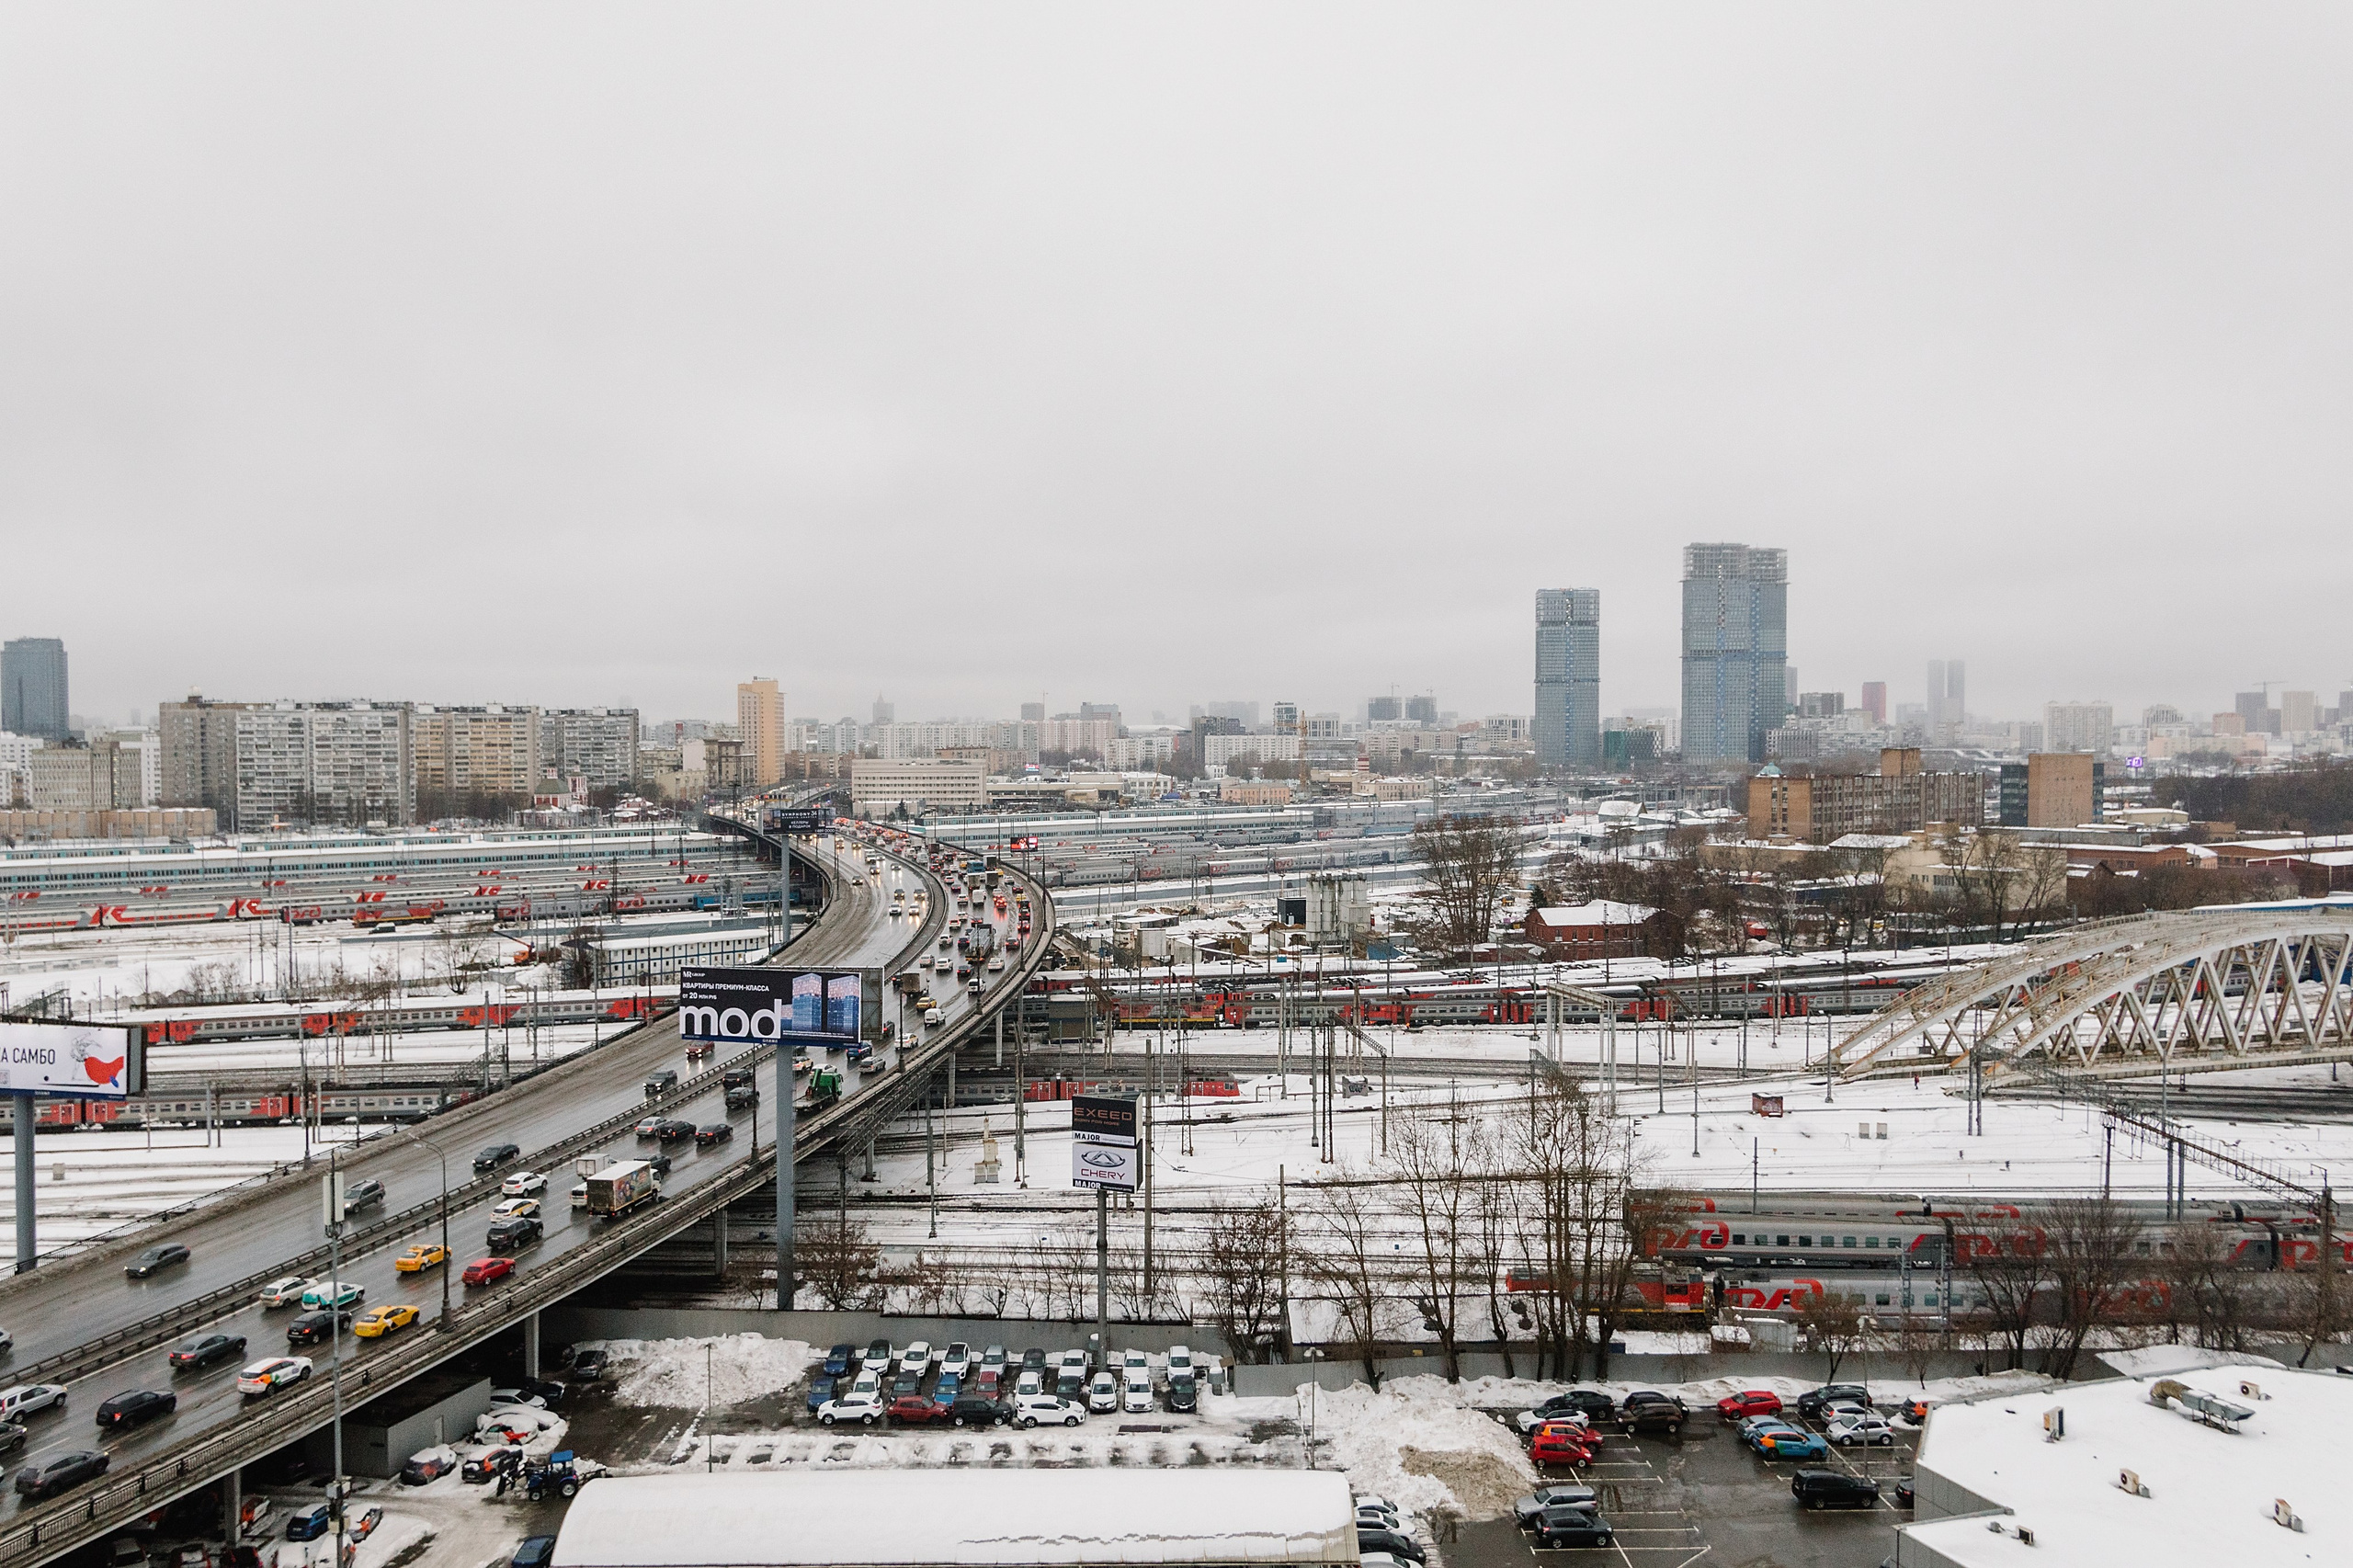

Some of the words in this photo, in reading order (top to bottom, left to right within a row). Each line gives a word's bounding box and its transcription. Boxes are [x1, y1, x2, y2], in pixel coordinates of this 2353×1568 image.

[715, 983, 769, 992] ПРЕМИУМ-КЛАССА
[679, 998, 781, 1039] mod
[13, 1048, 55, 1064] САМБО
[1074, 1107, 1132, 1120] EXEED
[1074, 1132, 1100, 1141] MAJOR
[1081, 1168, 1125, 1180] CHERY
[1074, 1180, 1101, 1189] MAJOR
